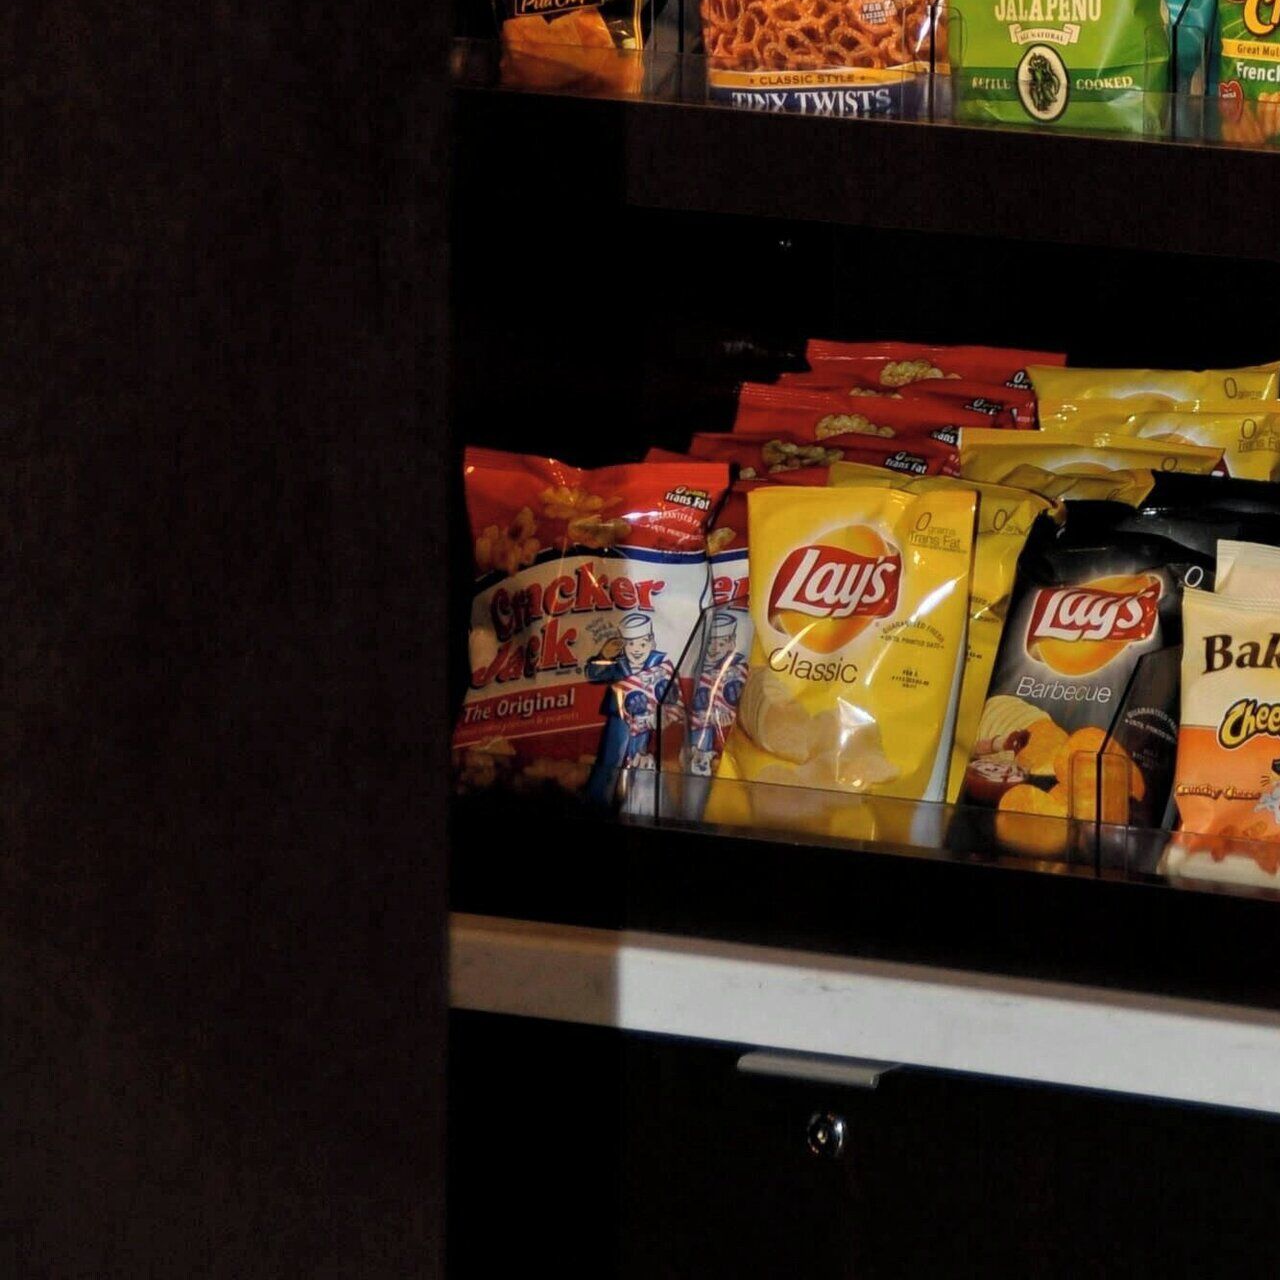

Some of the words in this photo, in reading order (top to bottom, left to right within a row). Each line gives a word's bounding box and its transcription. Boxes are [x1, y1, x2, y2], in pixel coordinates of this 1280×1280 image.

[1237, 43, 1260, 55] Great
[759, 75, 814, 85] CLASSIC
[817, 73, 855, 83] STYLE
[1076, 76, 1133, 90] COOKED
[732, 91, 788, 108] TINY
[794, 88, 891, 113] TWISTS
[775, 549, 897, 616] Lay's
[1034, 590, 1155, 641] Lay's
[767, 647, 857, 685] Classic
[1016, 675, 1111, 703] Barbecue
[463, 704, 491, 722] The
[497, 687, 576, 717] Original
